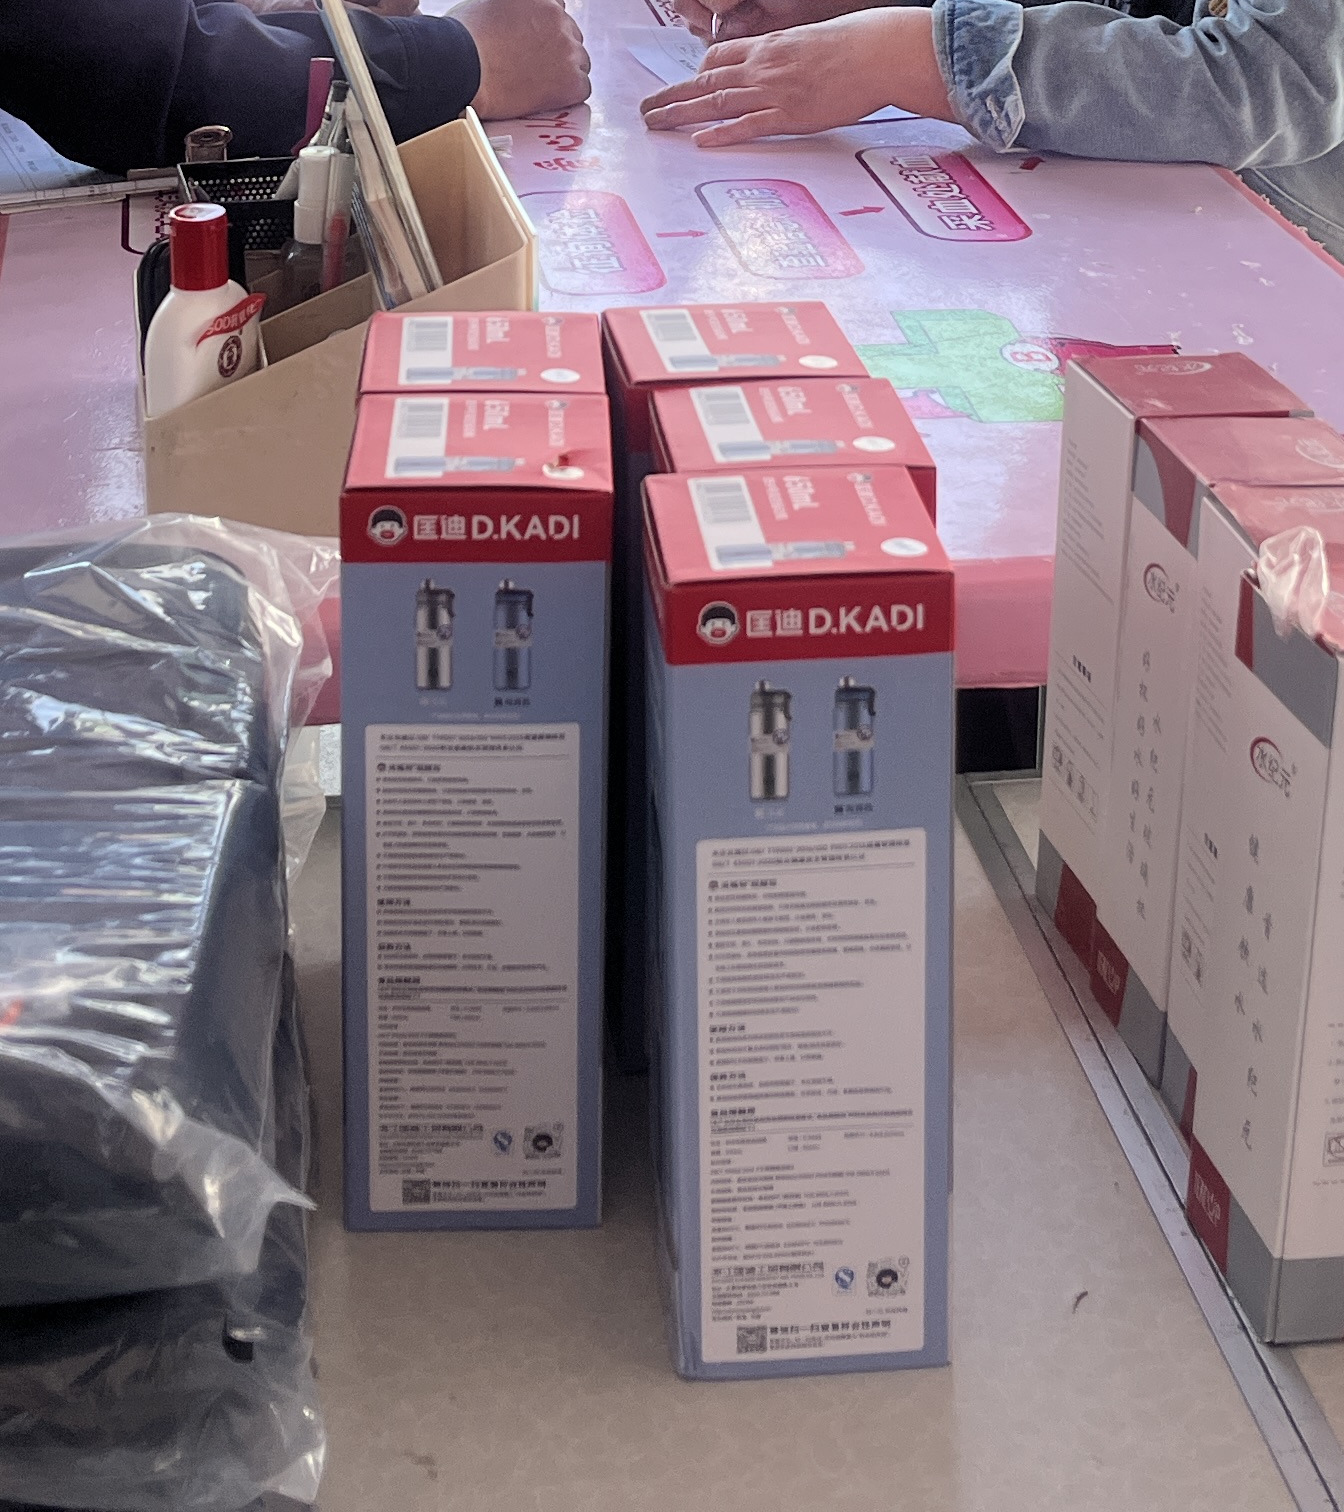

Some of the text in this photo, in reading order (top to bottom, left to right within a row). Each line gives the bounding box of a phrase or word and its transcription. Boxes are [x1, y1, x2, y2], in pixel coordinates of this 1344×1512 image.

[888, 154, 995, 232] 采血处献血
